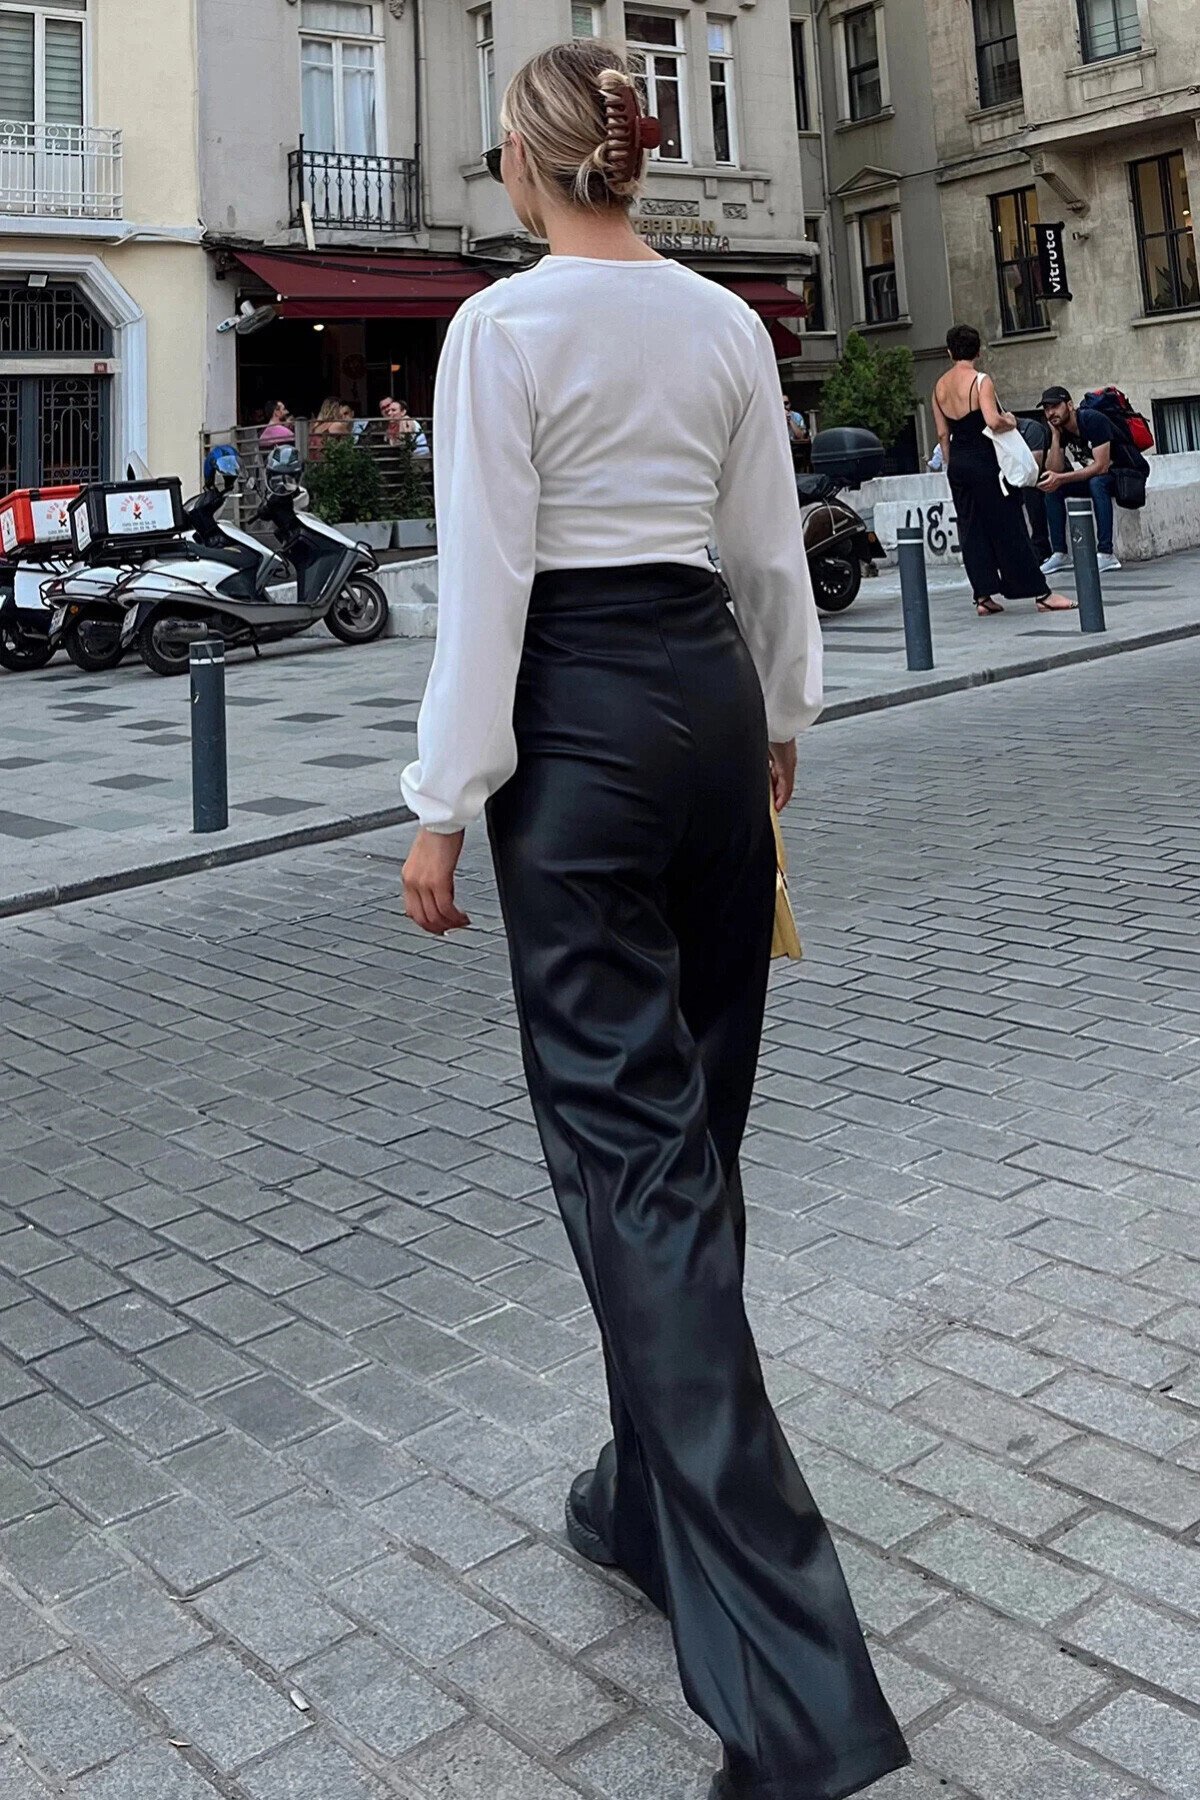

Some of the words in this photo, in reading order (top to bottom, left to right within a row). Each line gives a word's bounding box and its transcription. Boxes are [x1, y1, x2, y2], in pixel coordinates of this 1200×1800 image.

[646, 232, 683, 250] MISS
[692, 234, 730, 253] PIZZA
[1045, 230, 1061, 293] vitruta
